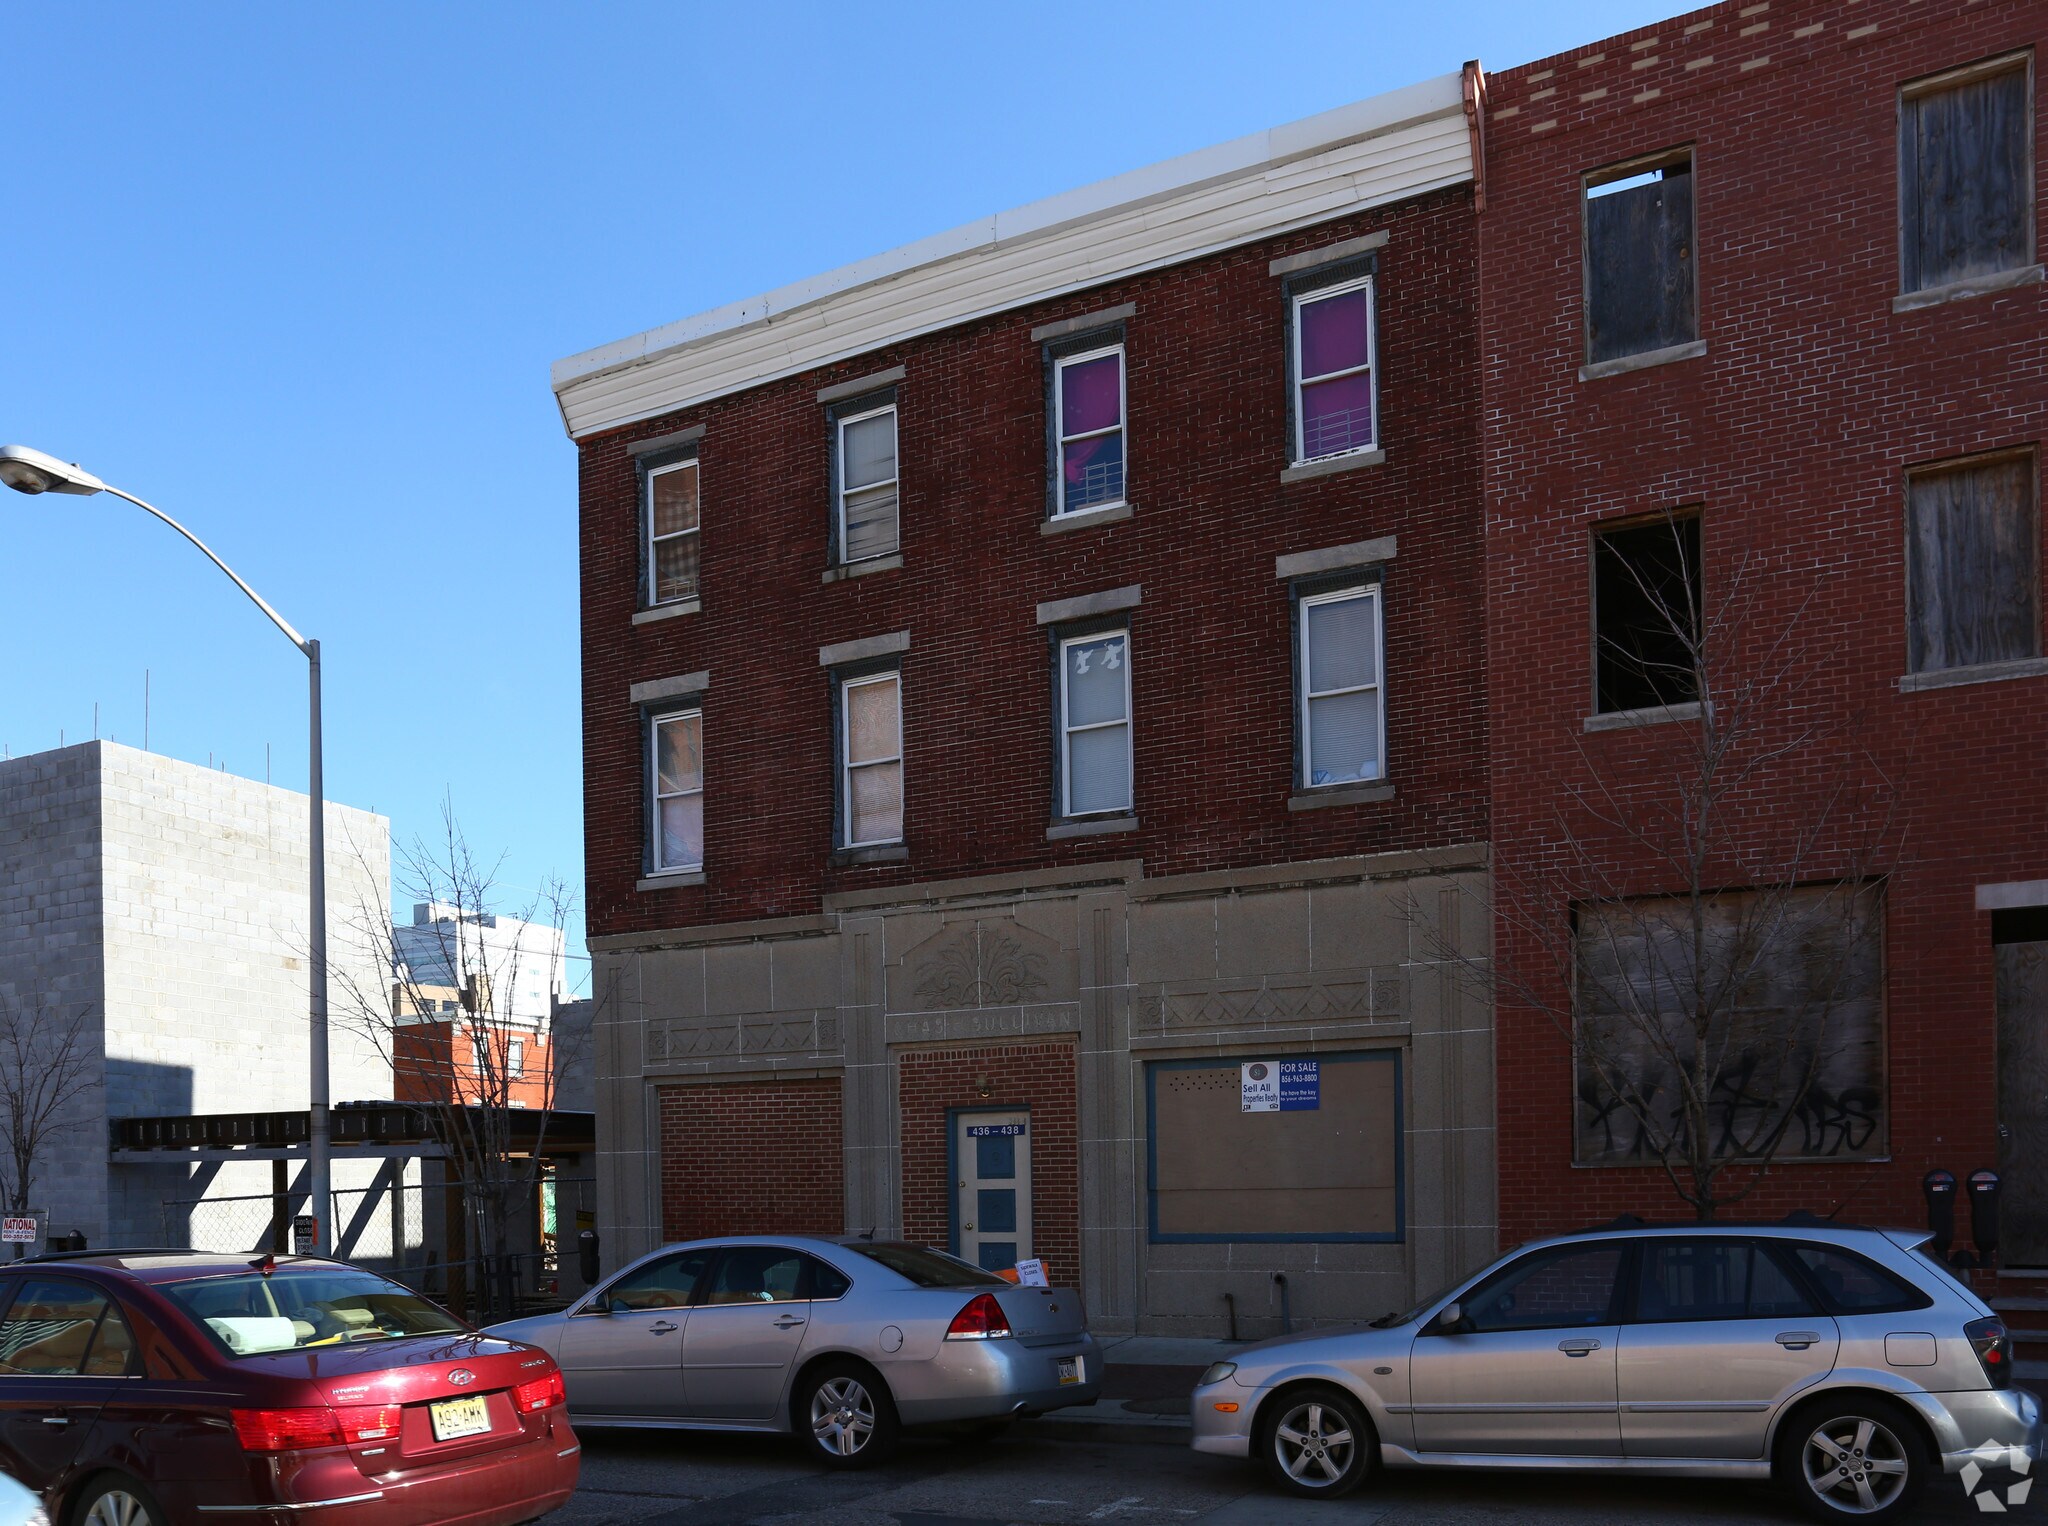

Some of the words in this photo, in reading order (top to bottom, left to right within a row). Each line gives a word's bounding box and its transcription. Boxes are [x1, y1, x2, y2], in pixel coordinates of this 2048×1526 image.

[1281, 1063, 1296, 1073] FOR
[1298, 1062, 1317, 1072] SALE
[1281, 1074, 1317, 1083] 856-963-8800
[1243, 1084, 1258, 1093] Sell
[1260, 1083, 1271, 1092] All
[1243, 1094, 1264, 1104] Properties
[1265, 1093, 1278, 1103] Realty
[972, 1127, 990, 1136] 436
[1001, 1126, 1019, 1135] 438
[4, 1219, 35, 1230] NATIONAL
